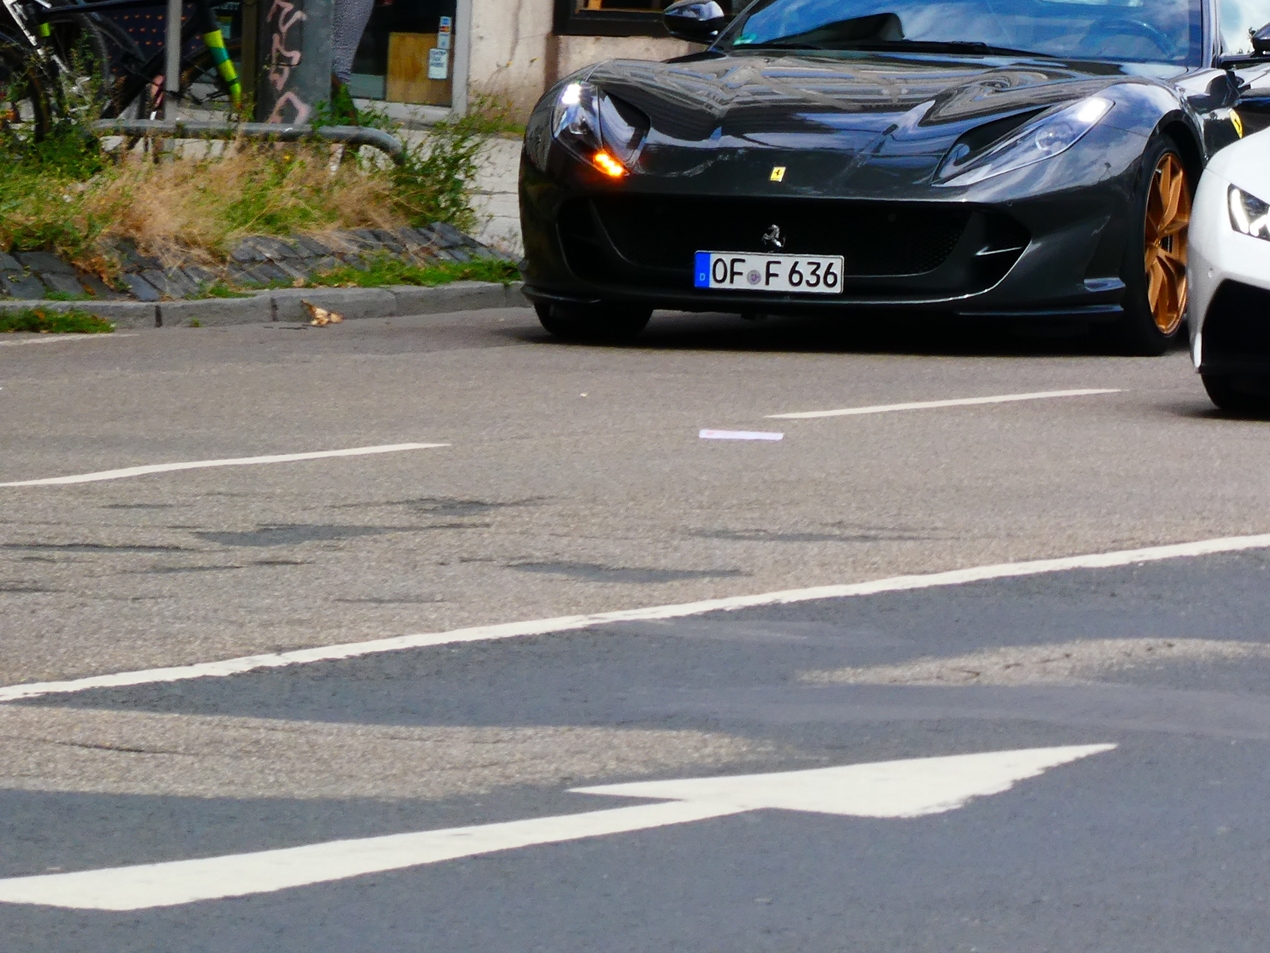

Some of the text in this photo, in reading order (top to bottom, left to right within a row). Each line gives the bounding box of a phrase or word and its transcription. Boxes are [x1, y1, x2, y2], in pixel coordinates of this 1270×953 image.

[712, 257, 838, 288] OF F 636
